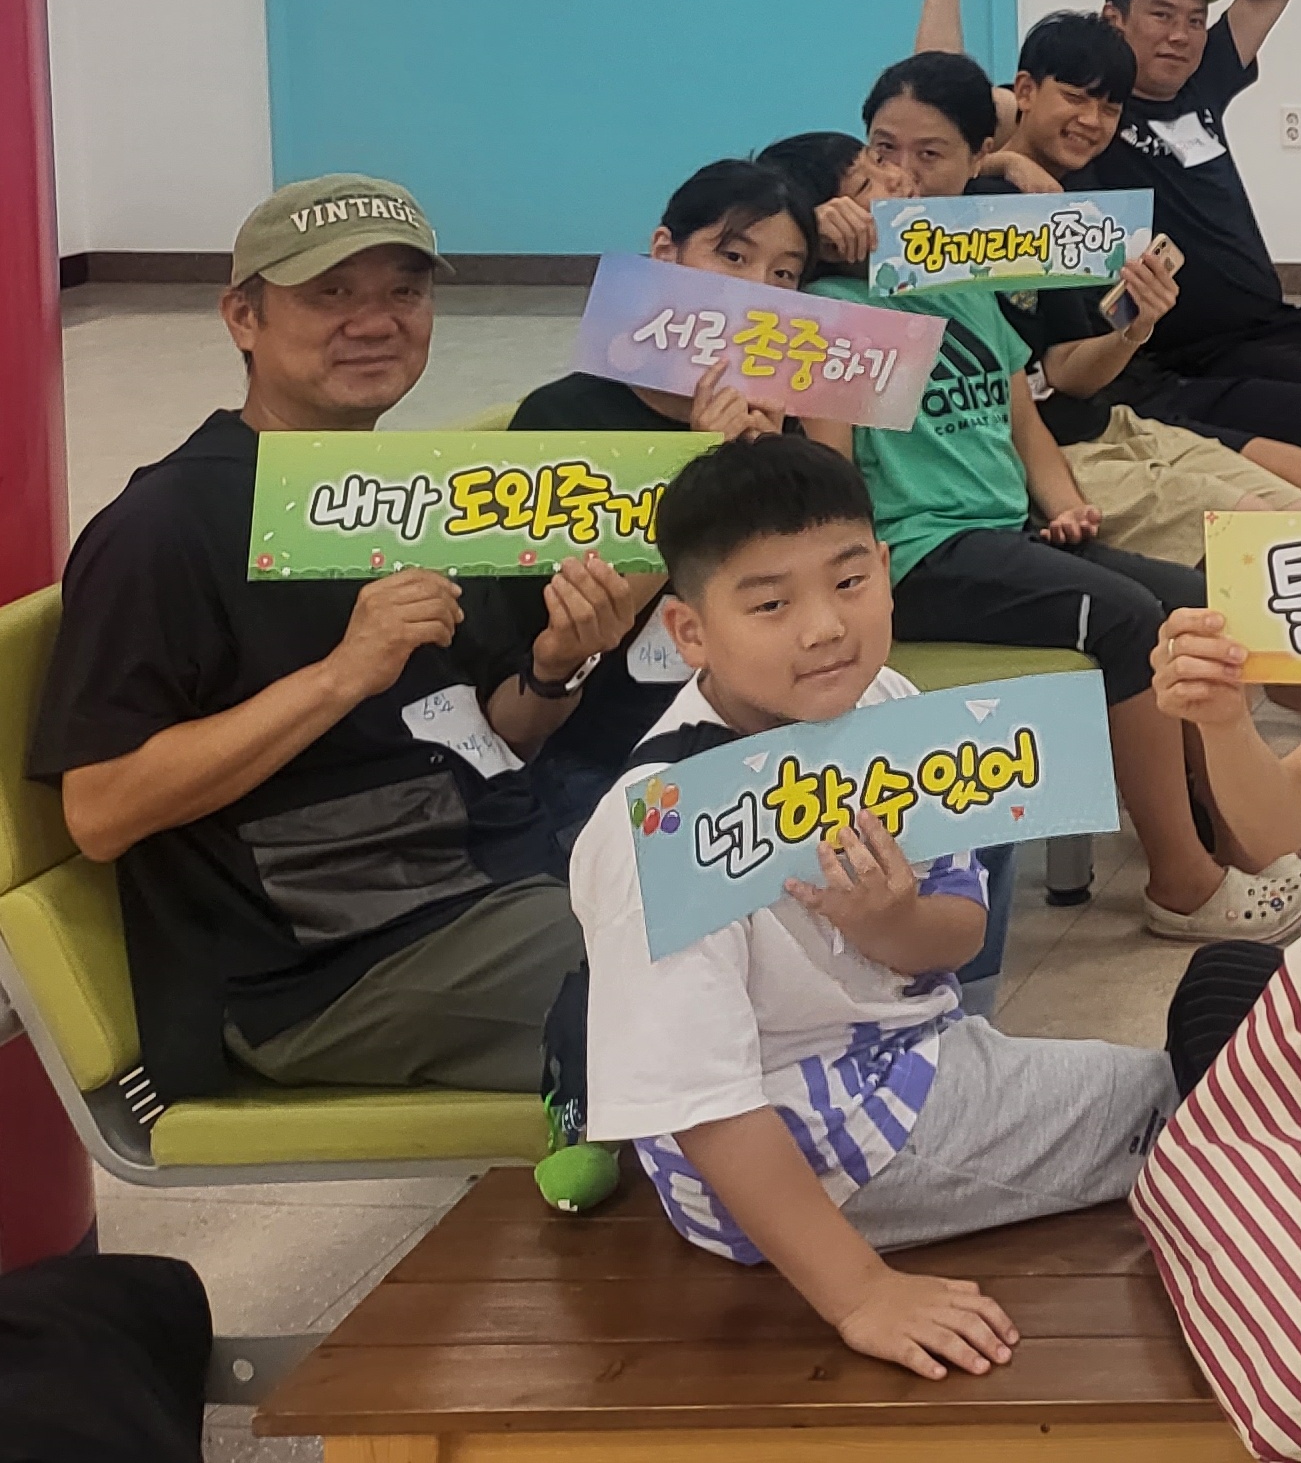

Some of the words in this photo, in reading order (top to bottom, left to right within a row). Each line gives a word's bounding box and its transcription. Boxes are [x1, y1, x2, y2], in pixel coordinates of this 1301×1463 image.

[289, 197, 421, 233] VINTAGE
[901, 219, 1051, 274] 함께라서
[1051, 210, 1125, 270] 좋아
[632, 307, 729, 367] 서로
[732, 309, 899, 394] 존중하기
[310, 473, 442, 541] 내가
[443, 459, 669, 545] 도와줄게
[695, 789, 774, 879] 넌
